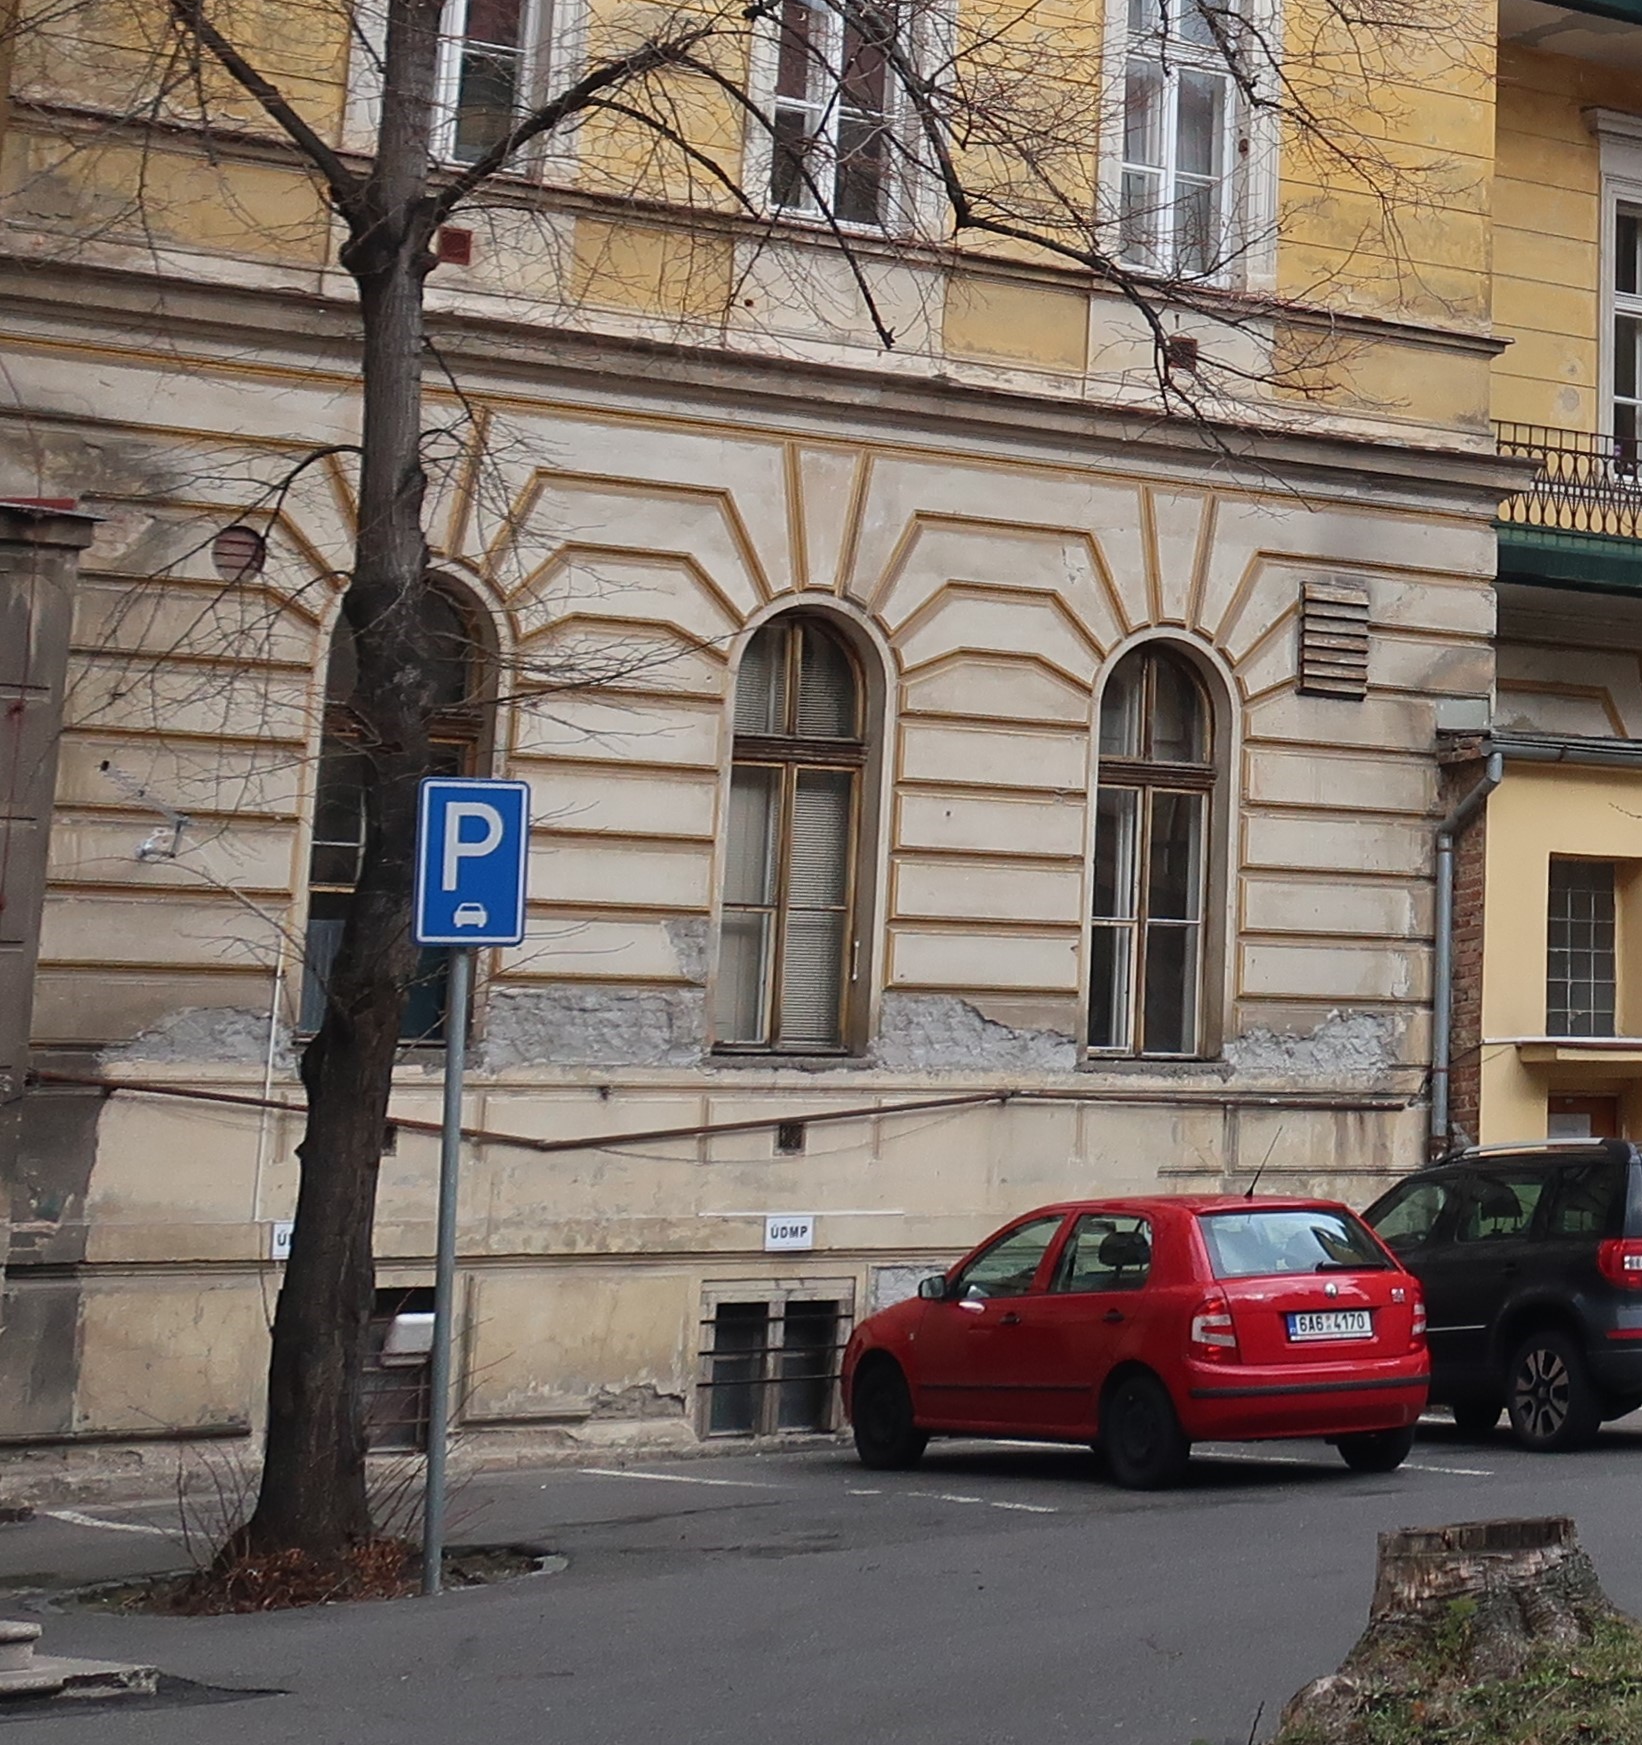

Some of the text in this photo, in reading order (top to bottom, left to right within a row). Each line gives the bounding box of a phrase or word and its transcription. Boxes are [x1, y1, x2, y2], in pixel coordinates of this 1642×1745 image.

[442, 801, 503, 892] P
[770, 1223, 808, 1239] ÚDMP
[1299, 1313, 1366, 1333] 6A6 4170
